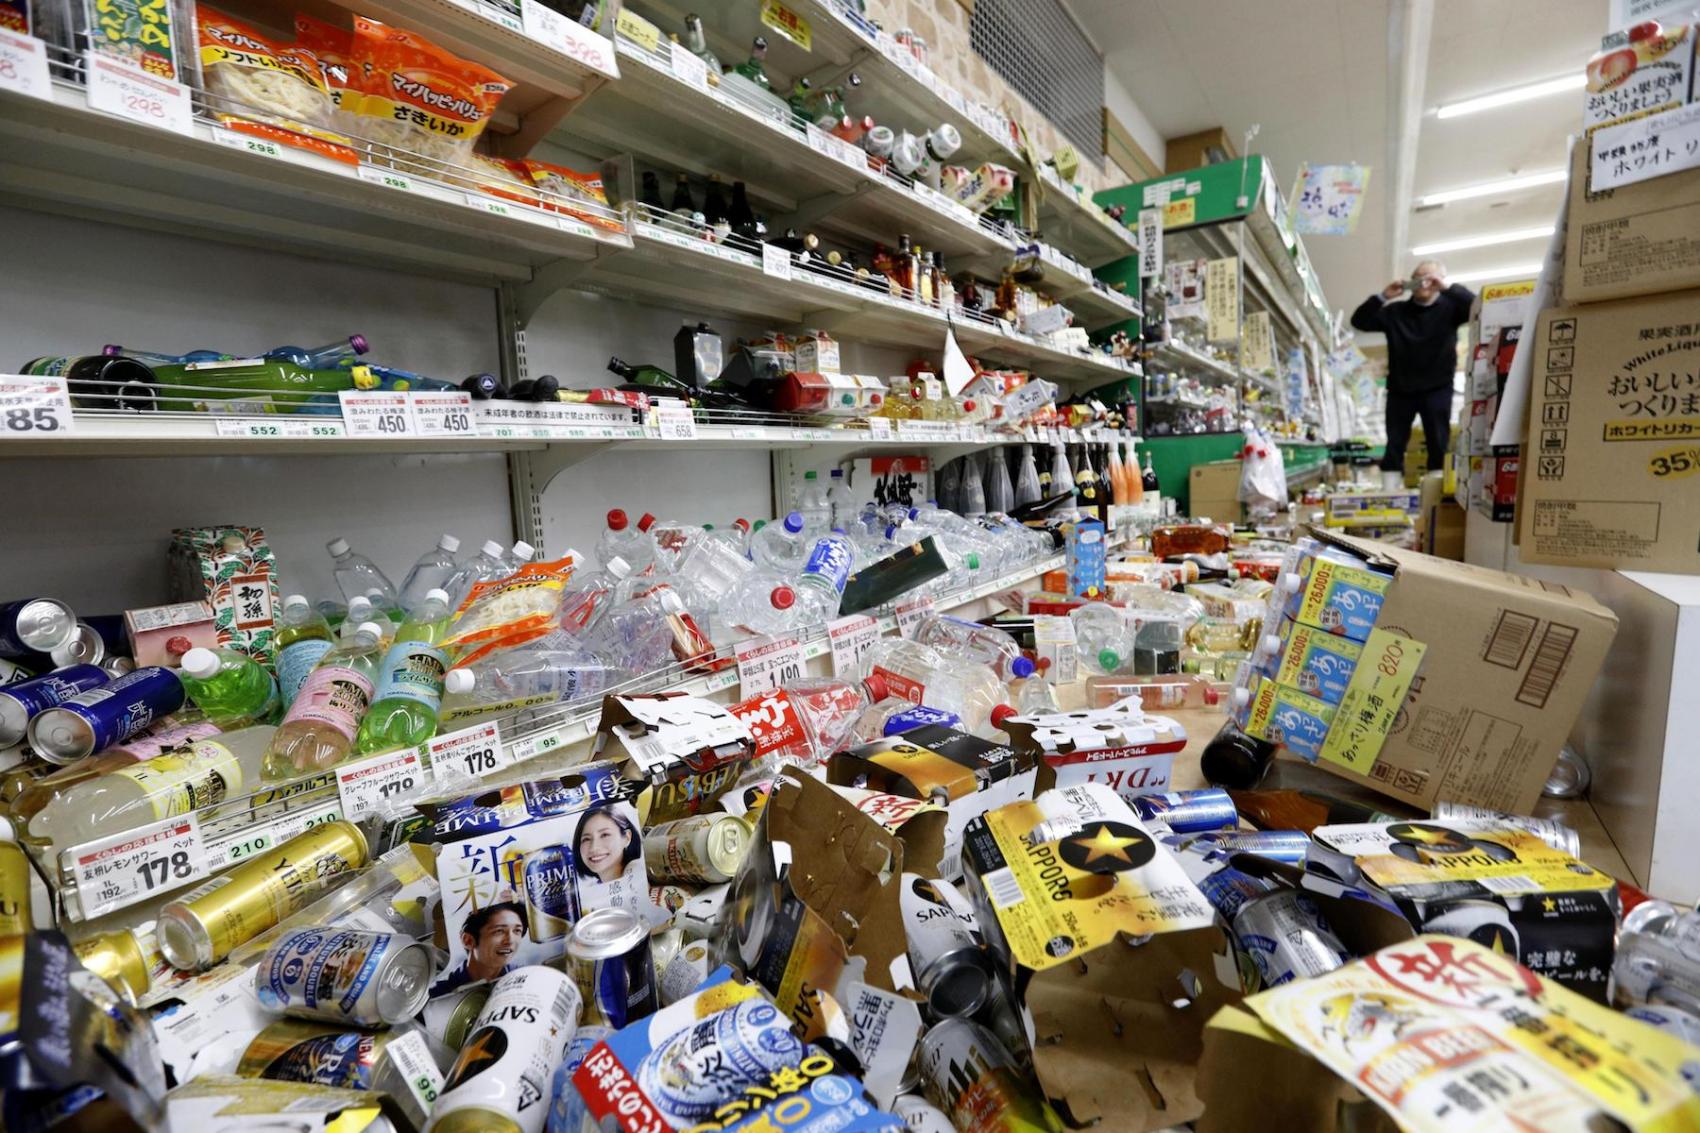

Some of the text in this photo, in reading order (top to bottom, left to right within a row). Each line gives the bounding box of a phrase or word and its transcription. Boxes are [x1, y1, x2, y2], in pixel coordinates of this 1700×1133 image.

[128, 96, 165, 118] 298
[394, 104, 464, 136] さきいか
[248, 141, 275, 155] 298
[1614, 150, 1676, 178] ホワイト
[385, 177, 407, 189] 298
[1608, 372, 1700, 397] おいしい
[6, 407, 59, 431] 85
[251, 426, 277, 435] 552
[313, 426, 337, 435] 552
[378, 415, 406, 433] 450
[443, 414, 469, 431] 450
[676, 425, 692, 437] 658
[240, 587, 264, 619] 初孫
[1378, 646, 1404, 676] 820
[543, 739, 557, 748] 95
[464, 749, 496, 775] 178
[655, 759, 742, 805] YEBISU
[173, 836, 194, 848] ペット
[231, 838, 266, 858] 210
[137, 851, 193, 890] 178
[452, 835, 523, 913] 新
[526, 864, 575, 890] PRIME
[101, 886, 121, 900] 192
[104, 880, 115, 888] 1L
[1387, 941, 1512, 999] 新
[1527, 950, 1577, 968] 完璧な
[1532, 968, 1606, 981] ビールを。
[853, 989, 885, 1052] 黒ラベ
[361, 1035, 375, 1066] NEW
[415, 1077, 438, 1103] 99
[1436, 1063, 1531, 1119] 一番搾り
